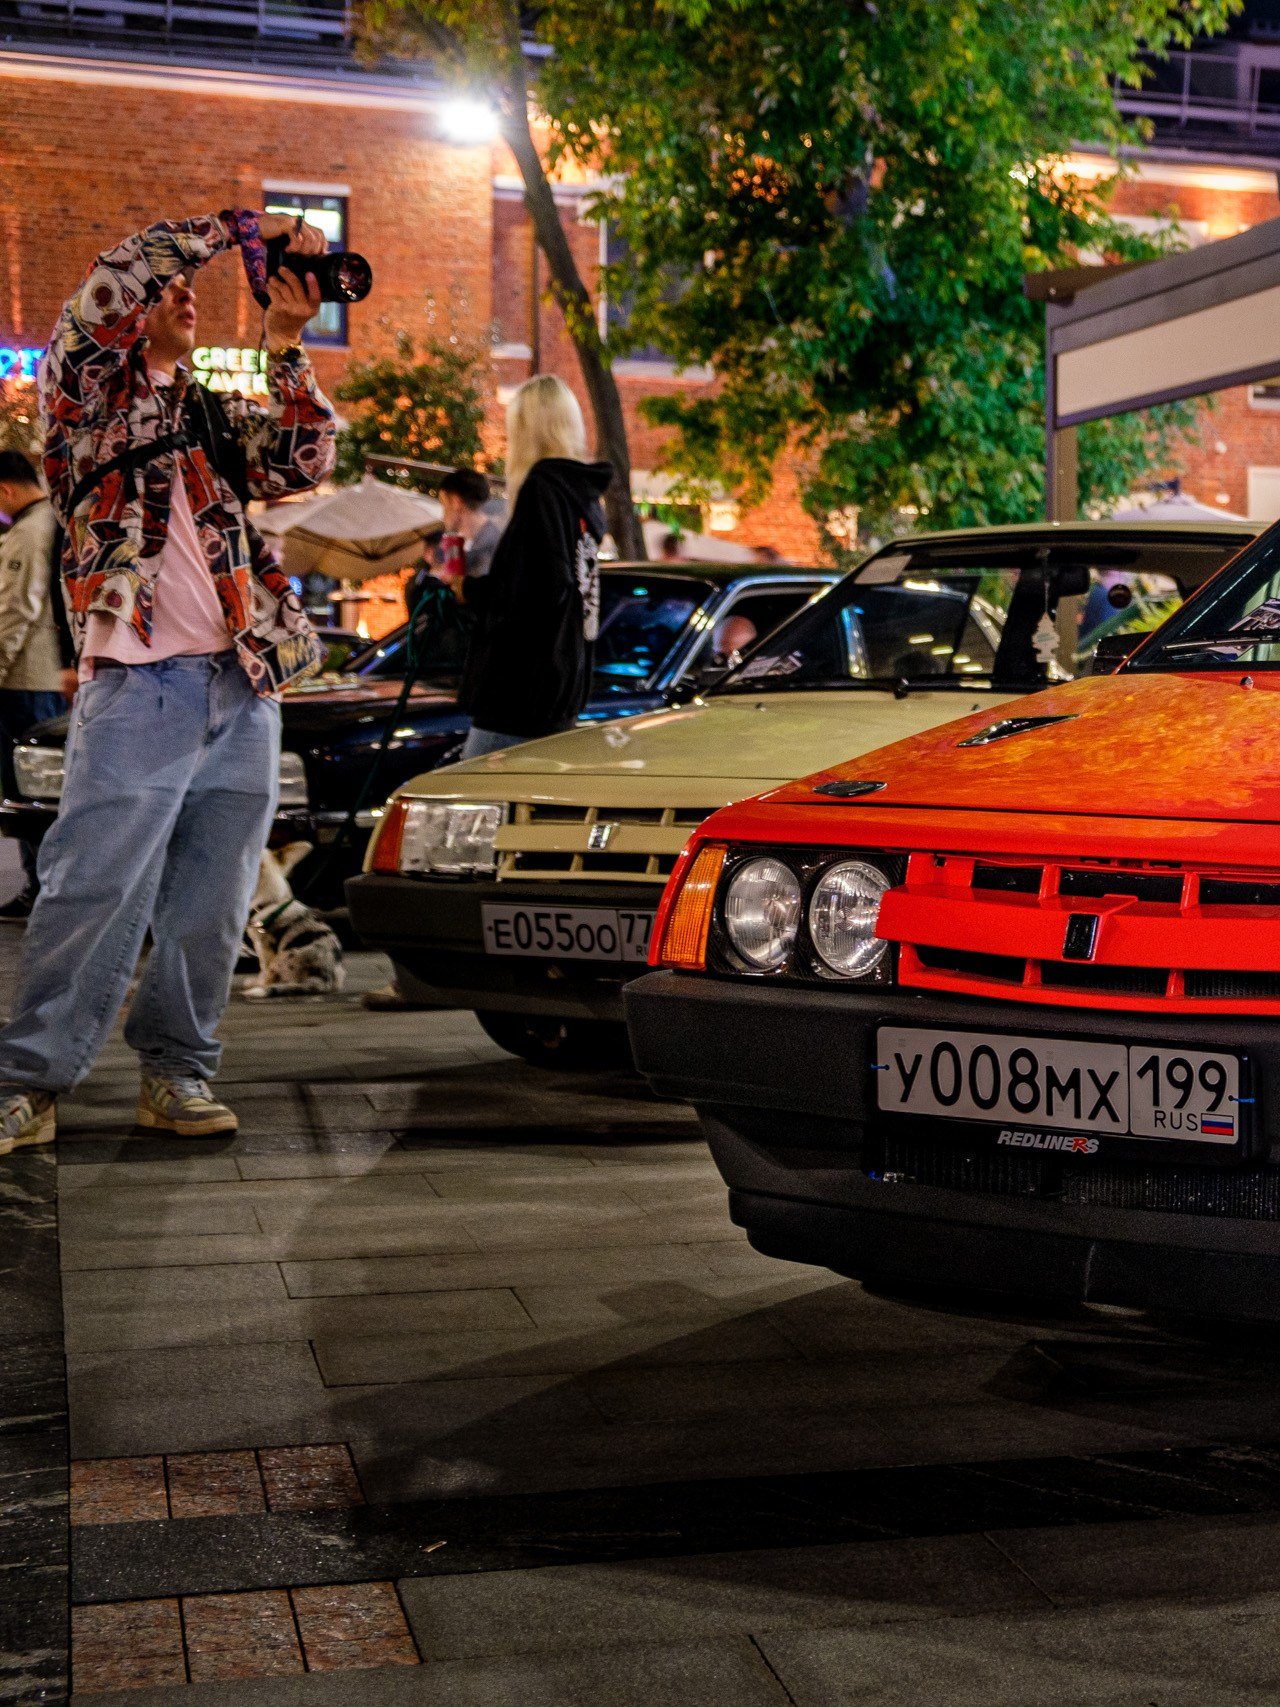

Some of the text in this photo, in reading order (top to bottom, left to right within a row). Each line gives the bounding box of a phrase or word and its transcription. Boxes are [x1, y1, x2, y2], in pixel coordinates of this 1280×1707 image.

[620, 914, 655, 944] 77
[894, 1041, 1227, 1123] У008МХ 199
[1154, 1110, 1198, 1132] RUS
[997, 1130, 1099, 1153] REDLINERS
